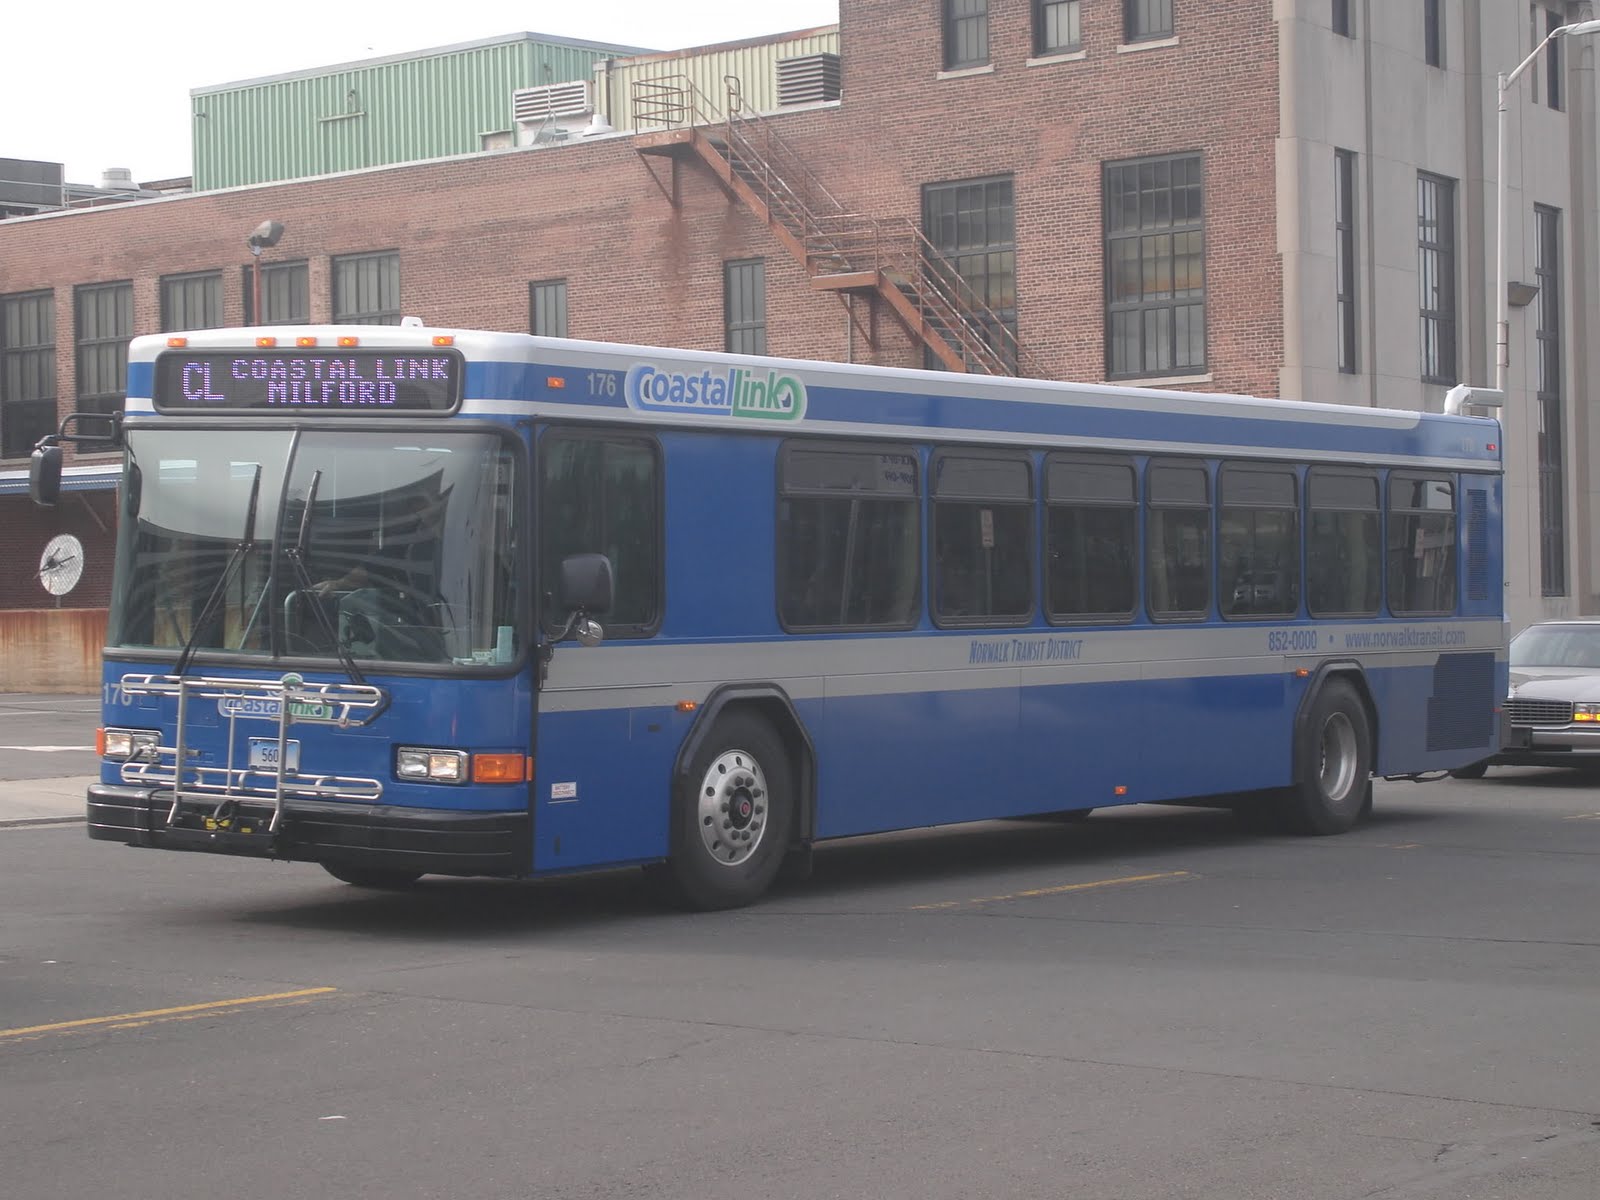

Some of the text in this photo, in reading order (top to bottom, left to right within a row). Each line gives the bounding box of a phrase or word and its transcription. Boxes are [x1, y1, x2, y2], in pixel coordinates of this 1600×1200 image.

[181, 361, 225, 401] CL
[230, 358, 450, 380] COASTAL LINK
[267, 380, 397, 404] MILFORD
[587, 371, 617, 397] 176
[1268, 625, 1466, 651] 852-0000 www.norwalktransit.com
